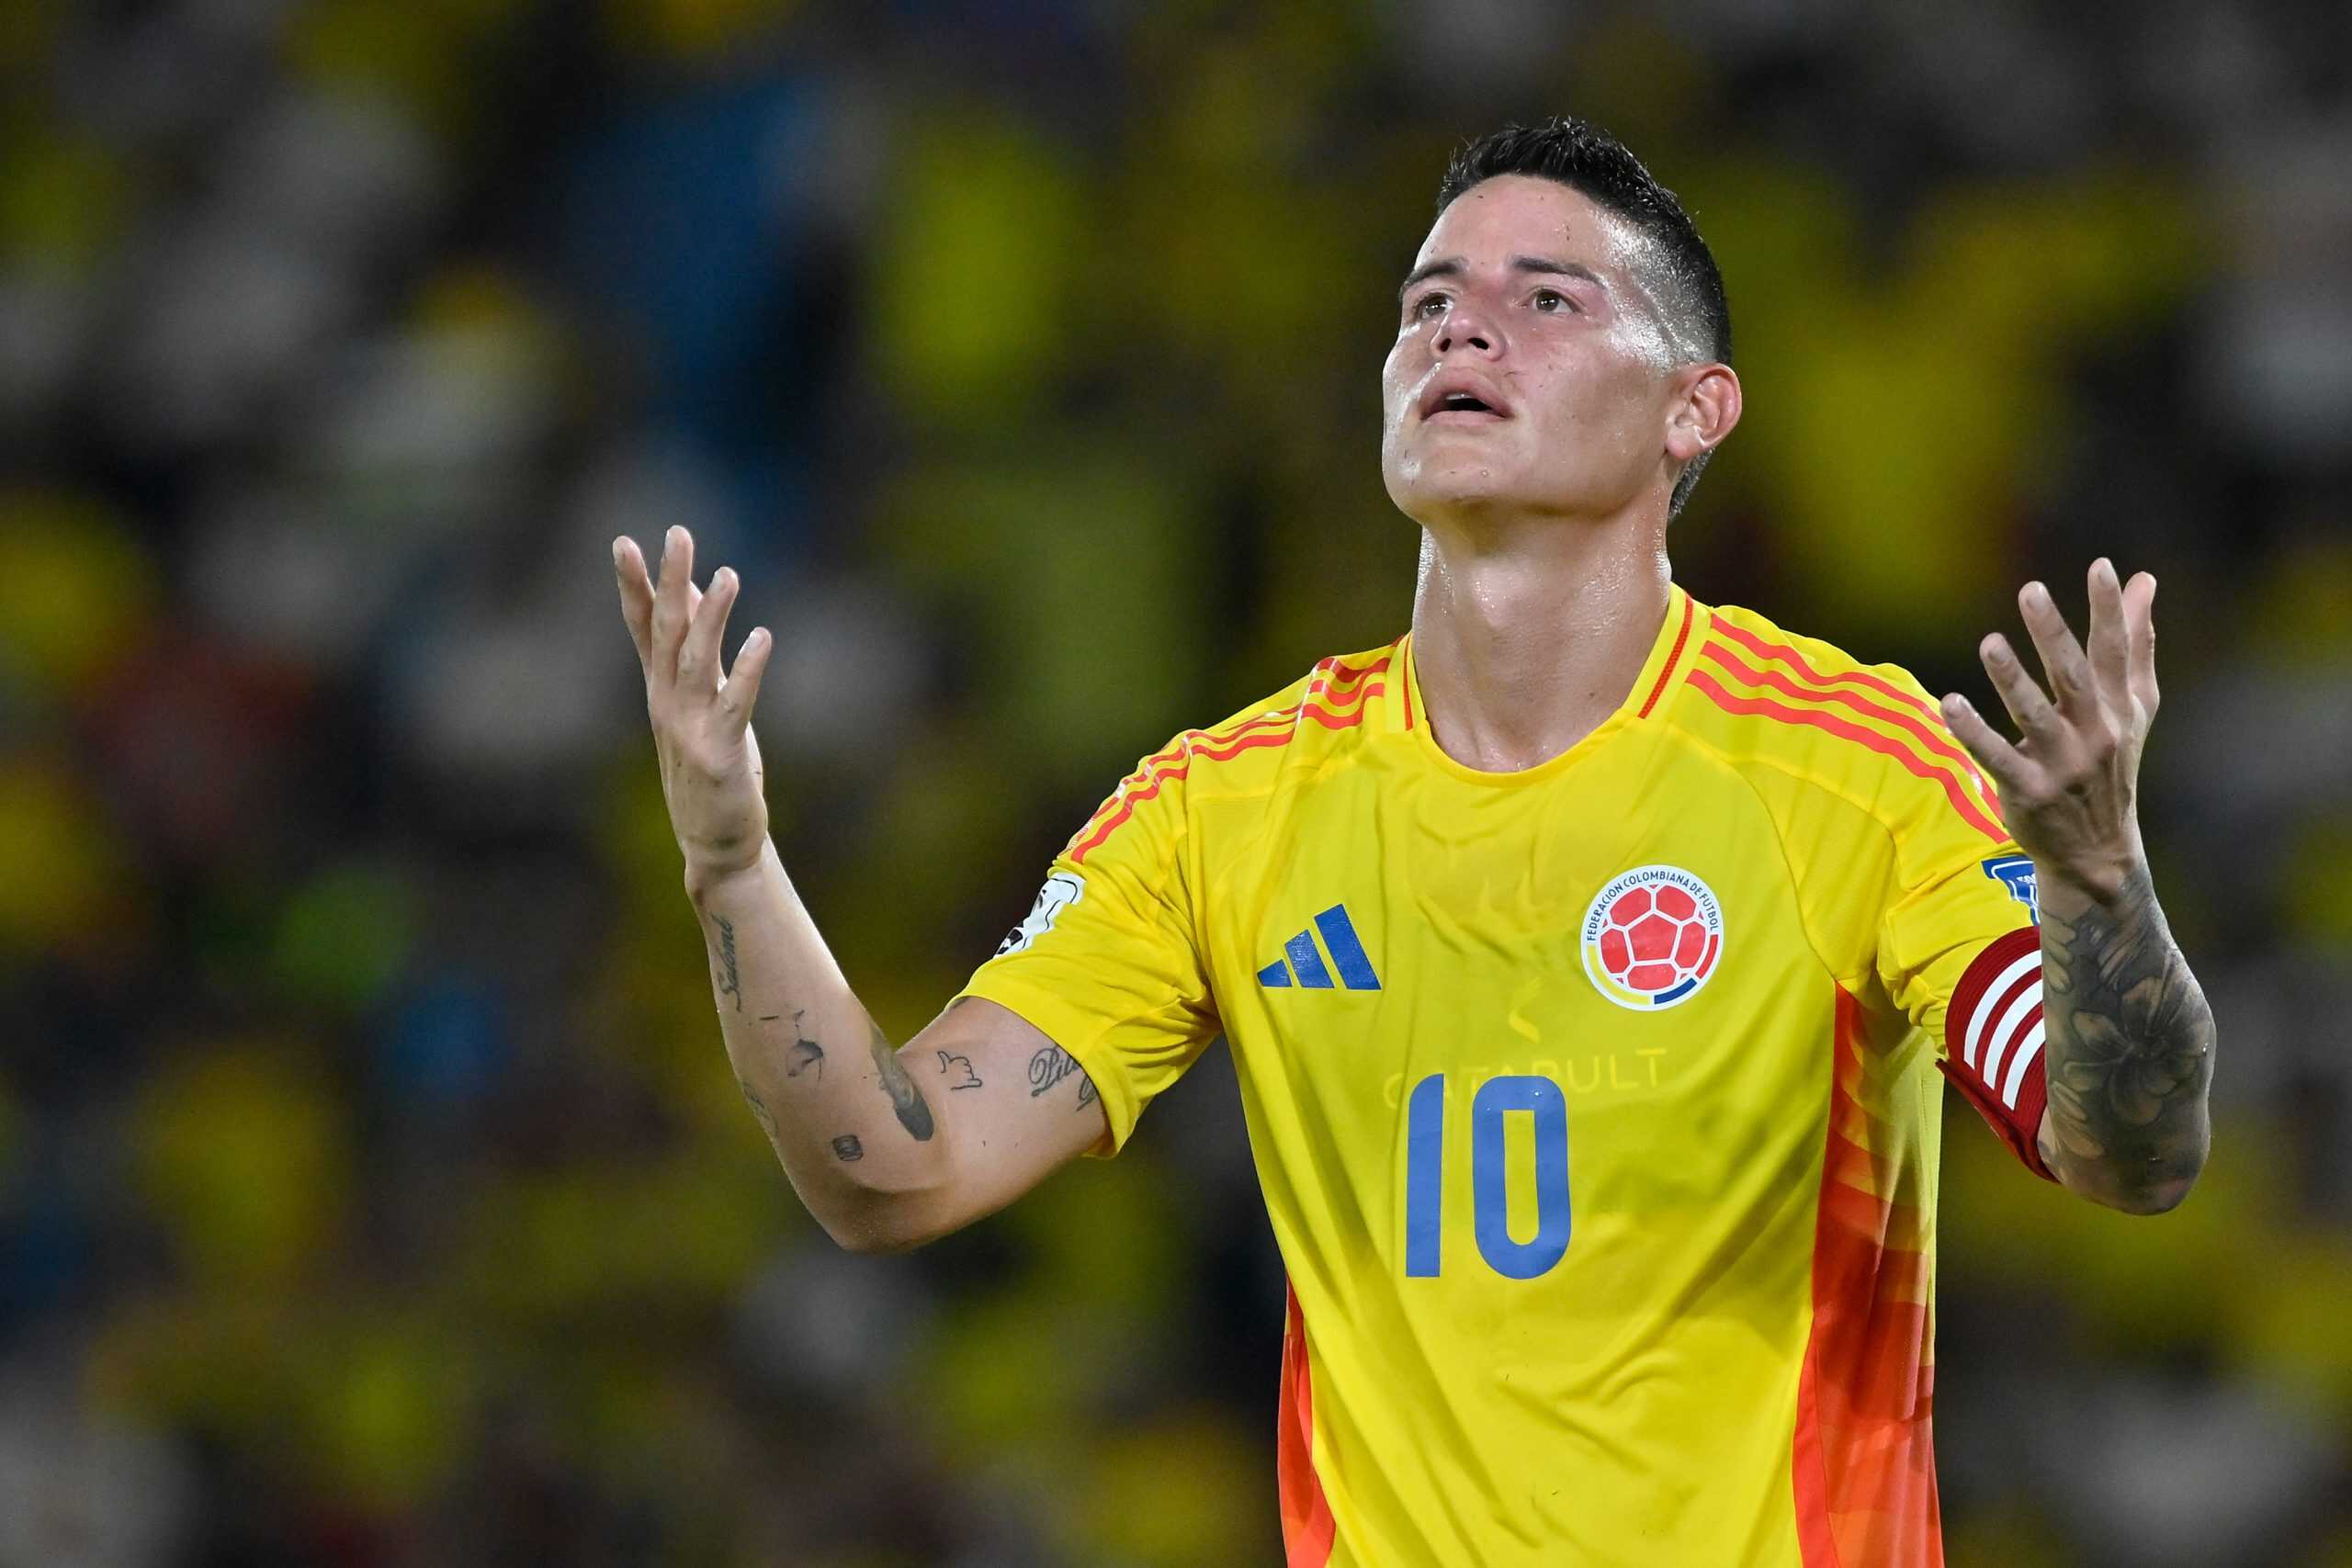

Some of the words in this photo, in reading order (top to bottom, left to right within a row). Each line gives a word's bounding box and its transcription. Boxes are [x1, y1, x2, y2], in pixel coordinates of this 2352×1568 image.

[1623, 871, 1690, 888] COLOMBIANA
[1690, 882, 1703, 896] DE
[1406, 1073, 1572, 1280] 10
